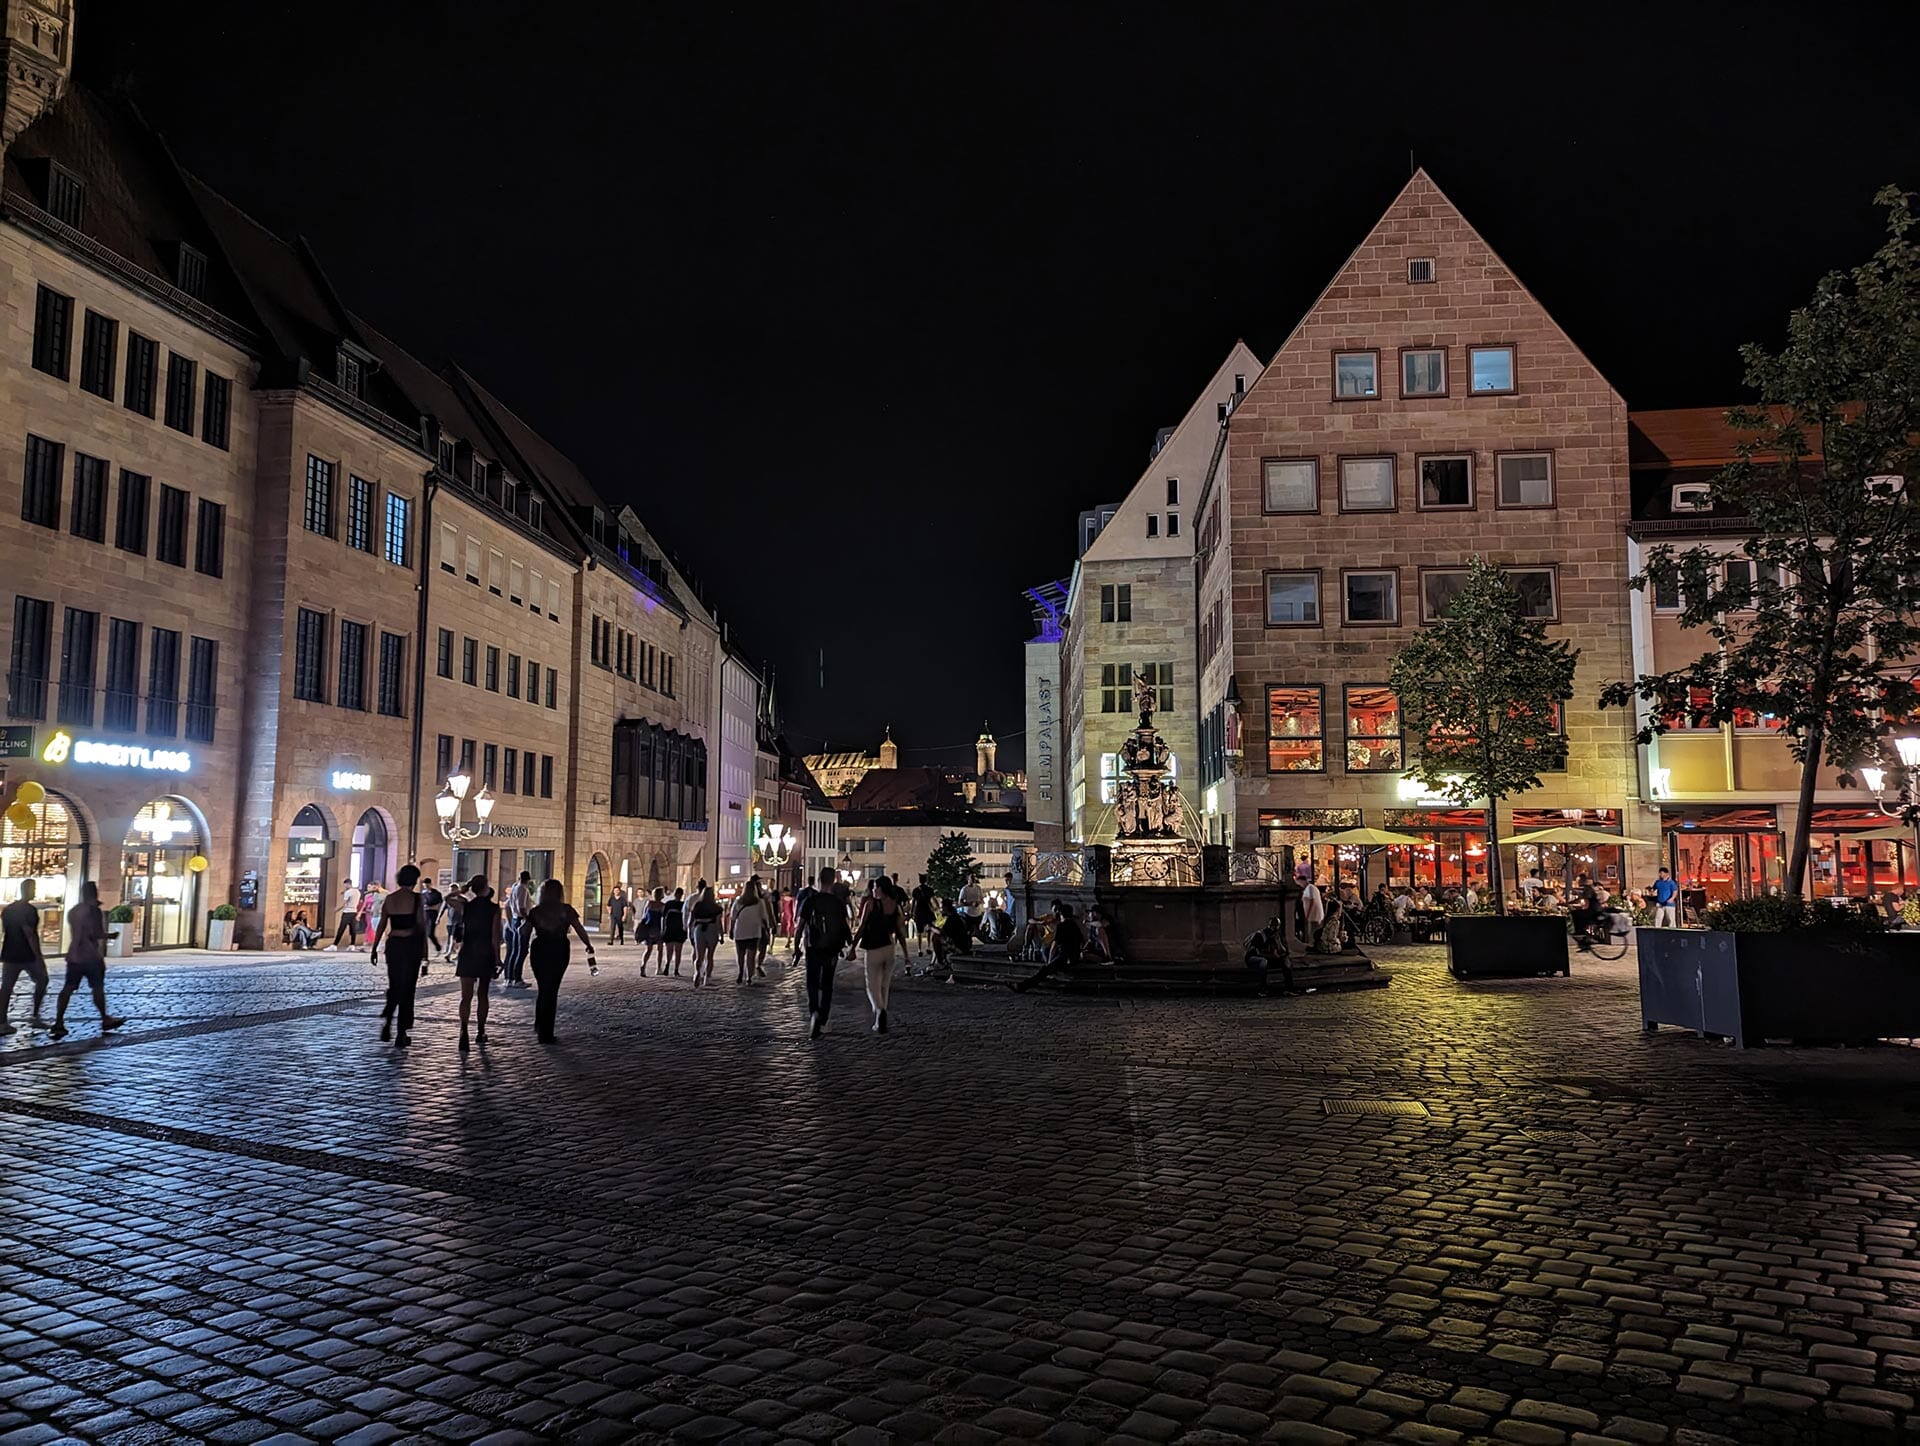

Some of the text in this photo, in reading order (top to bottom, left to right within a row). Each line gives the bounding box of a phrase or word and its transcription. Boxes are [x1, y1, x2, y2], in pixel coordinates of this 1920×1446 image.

[1039, 676, 1053, 801] FILMPALAST
[74, 741, 191, 773] BREITLING
[332, 771, 372, 791] LUSH
